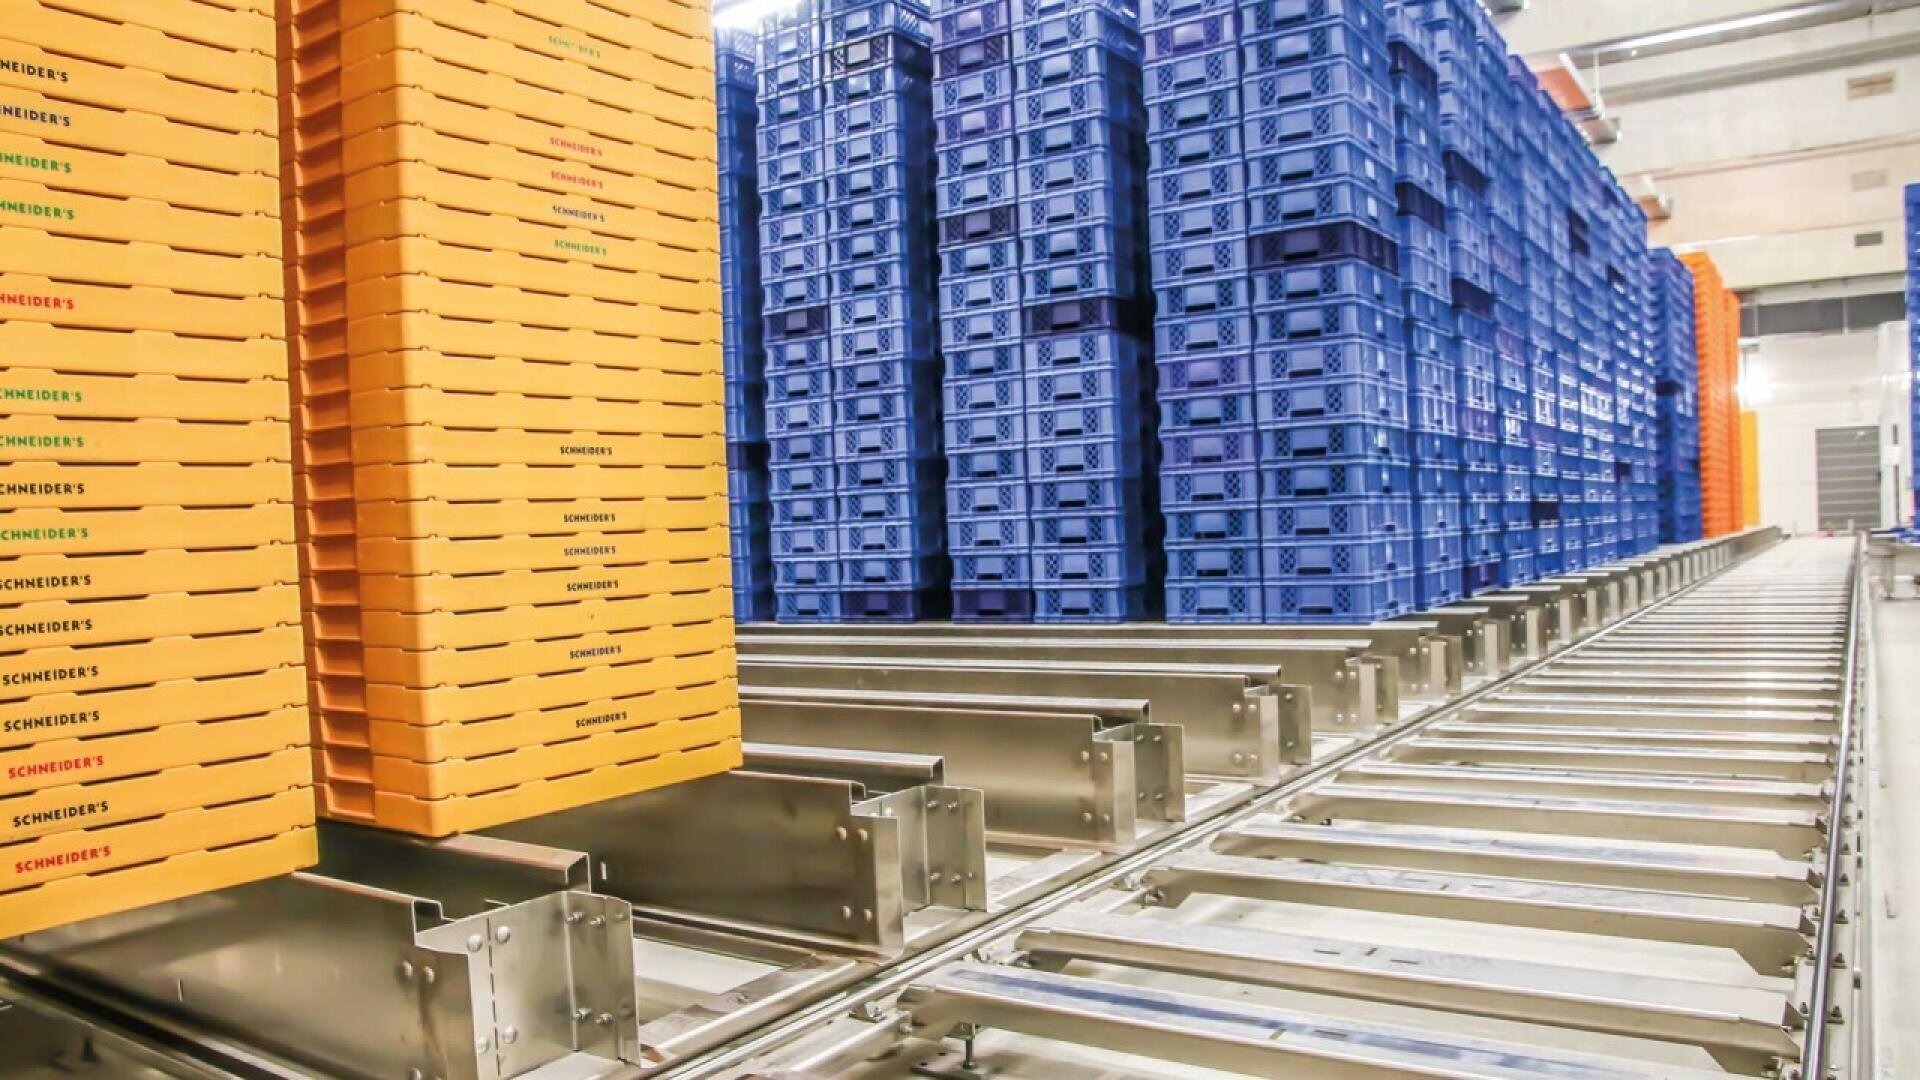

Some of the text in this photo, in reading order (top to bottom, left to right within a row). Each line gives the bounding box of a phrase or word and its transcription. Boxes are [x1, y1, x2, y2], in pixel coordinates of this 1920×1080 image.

[0, 104, 71, 127] NEIDER'S
[560, 446, 612, 456] SCHNEIDER'S
[564, 513, 615, 523] SCHNEIDER'S
[564, 546, 616, 557] SCHNEIDER'S
[567, 580, 618, 592] SCHNEIDER'S
[570, 645, 621, 660] SCHNEIDER'S
[2, 665, 99, 686] SCHNEIDER'S
[4, 710, 100, 732] SCHNEIDER'S
[576, 711, 627, 728] SCHNEIDER'S
[8, 755, 104, 780] SCHNEIDER'S
[13, 801, 109, 827] SCHNEIDER'S
[15, 845, 111, 873] SCHNEIDER'S
